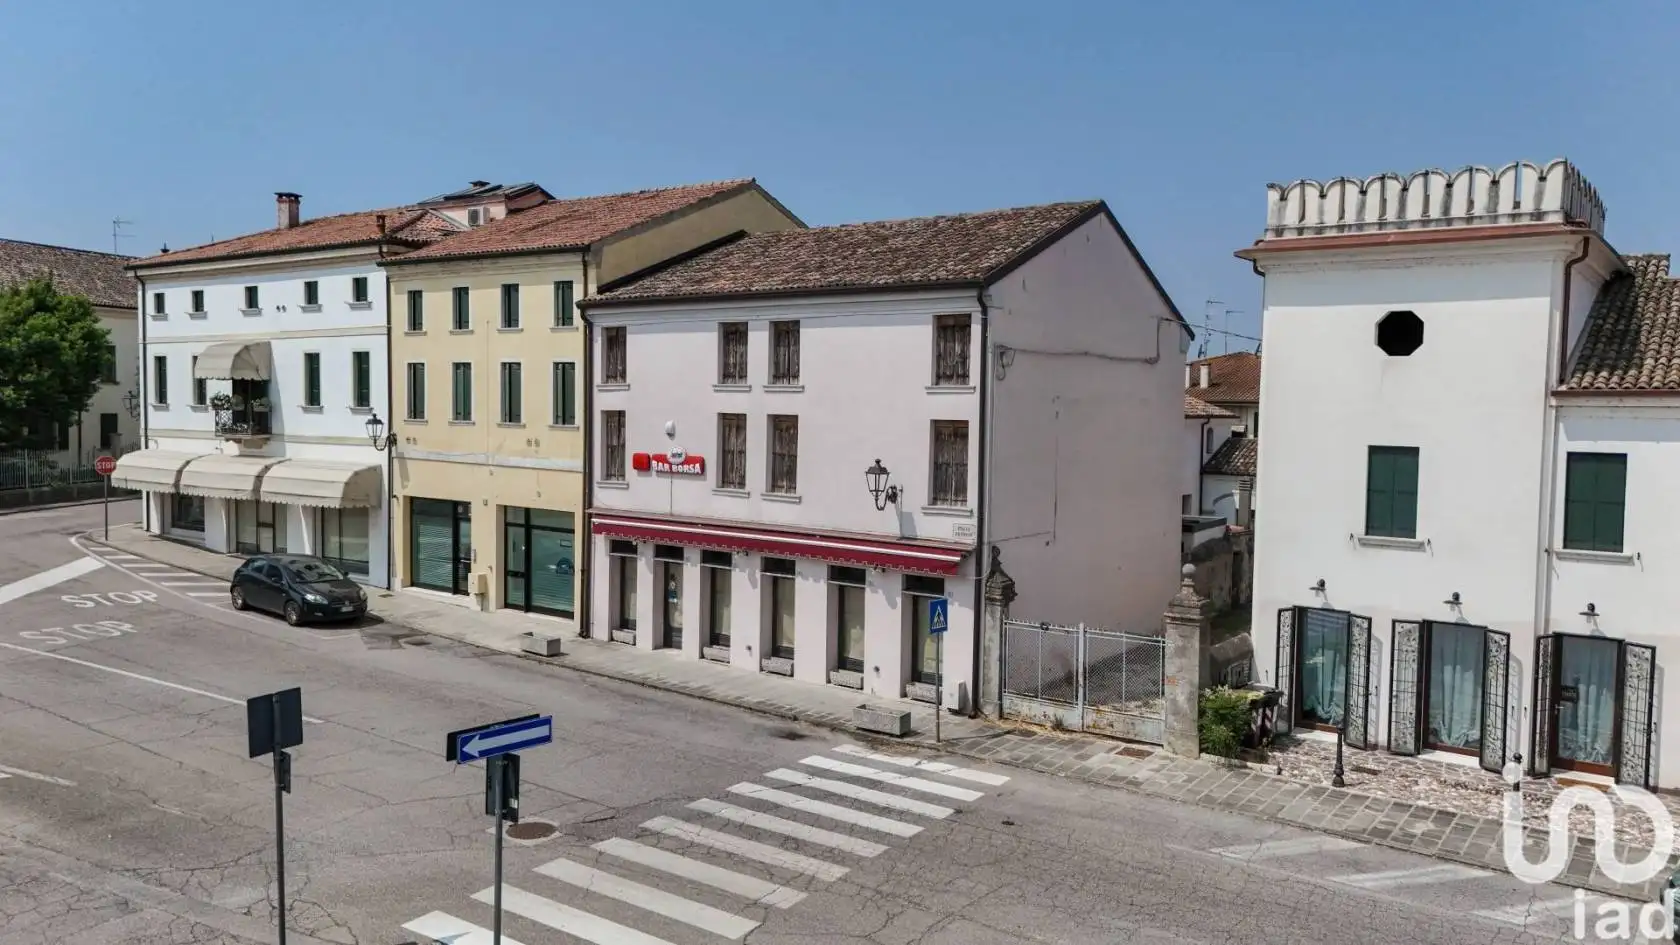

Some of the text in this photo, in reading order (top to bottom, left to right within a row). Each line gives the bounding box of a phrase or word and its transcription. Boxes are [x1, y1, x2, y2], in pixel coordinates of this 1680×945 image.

[96, 461, 115, 469] STOP
[652, 460, 702, 474] BAR BORSA
[61, 590, 158, 608] STOP
[19, 620, 138, 644] STOP
